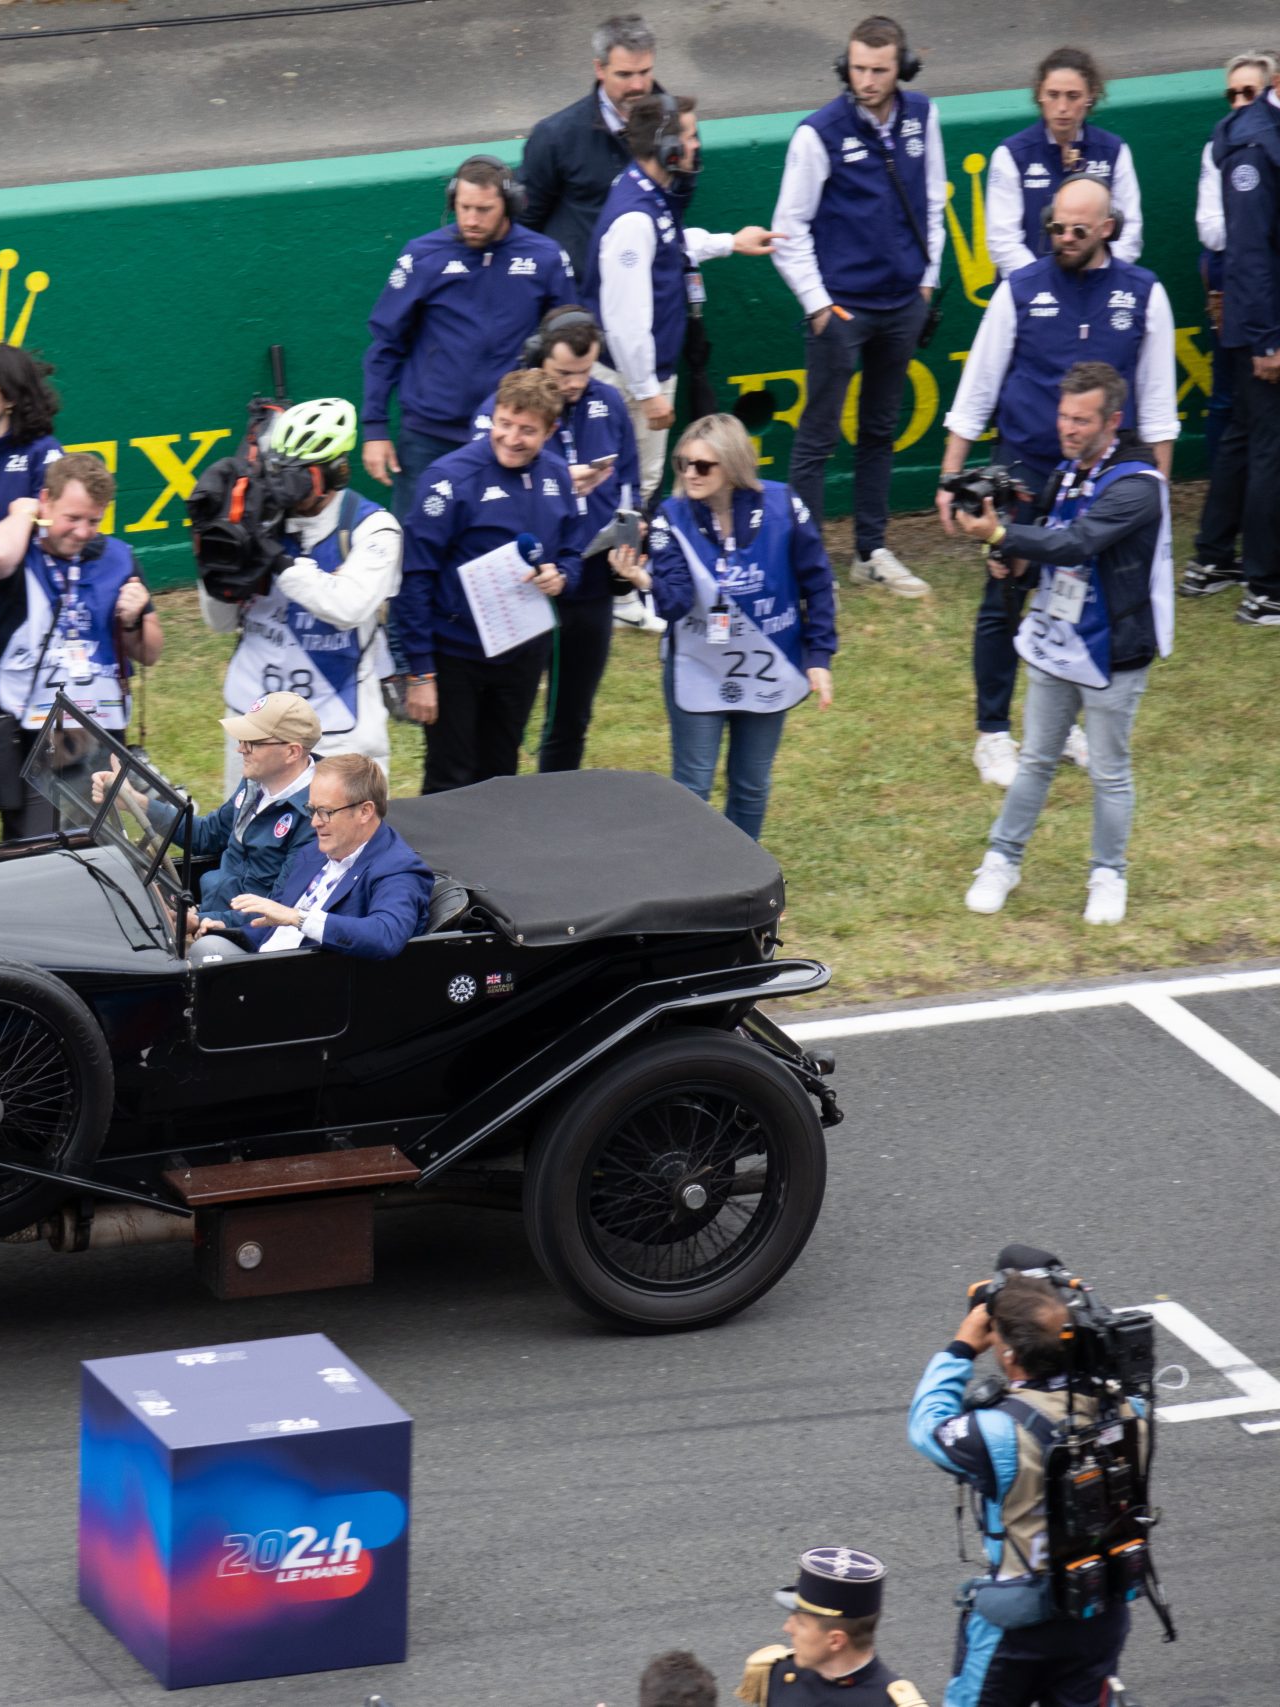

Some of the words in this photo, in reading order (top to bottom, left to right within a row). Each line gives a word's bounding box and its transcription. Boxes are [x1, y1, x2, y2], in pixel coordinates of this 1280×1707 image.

[753, 597, 776, 617] TV
[722, 650, 778, 682] 22
[262, 663, 314, 699] 68
[506, 973, 512, 982] 8
[275, 1570, 302, 1583] LE
[301, 1563, 358, 1581] MANS
